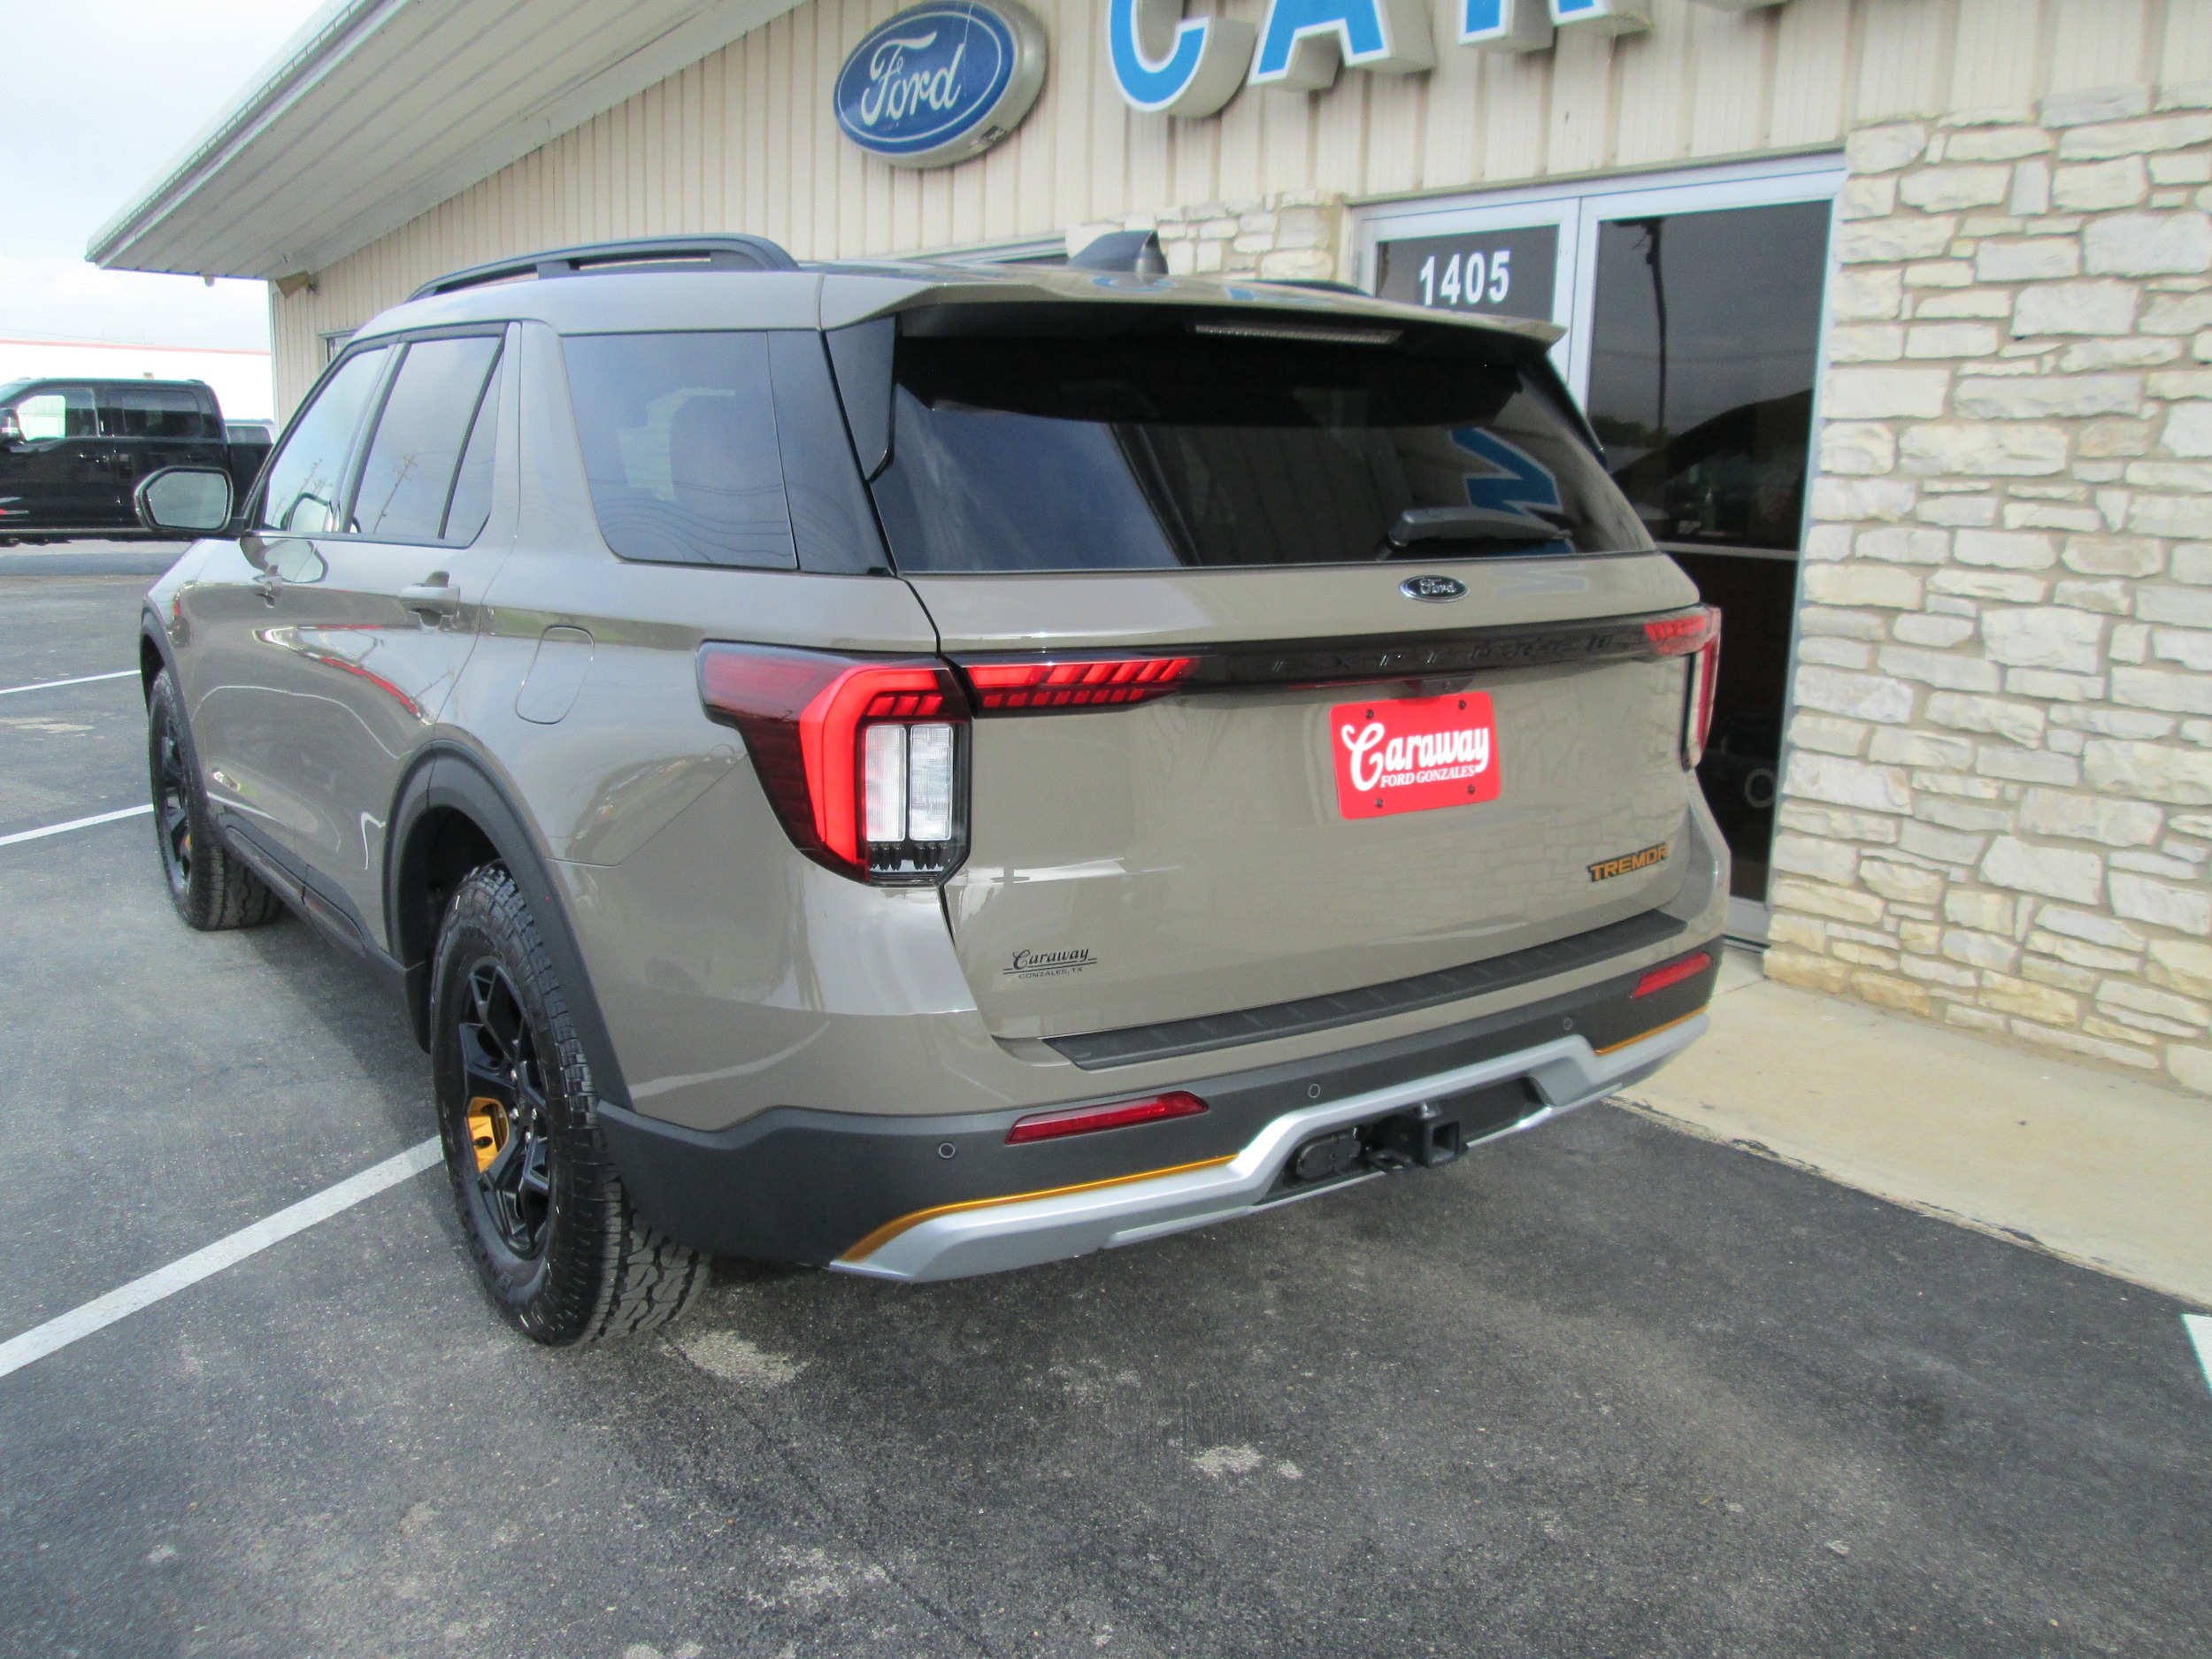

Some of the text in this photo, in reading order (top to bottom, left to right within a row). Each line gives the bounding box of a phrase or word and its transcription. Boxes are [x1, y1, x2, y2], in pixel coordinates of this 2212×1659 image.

[861, 31, 964, 127] Ford
[1419, 250, 1510, 306] 1405
[1419, 578, 1457, 595] Ford
[1341, 722, 1490, 791] Caraway
[1380, 765, 1476, 788] FORD GONZALES
[1588, 842, 1669, 881] TREMOR
[1012, 949, 1089, 970] Caraway
[1018, 969, 1070, 979] GONZALES,
